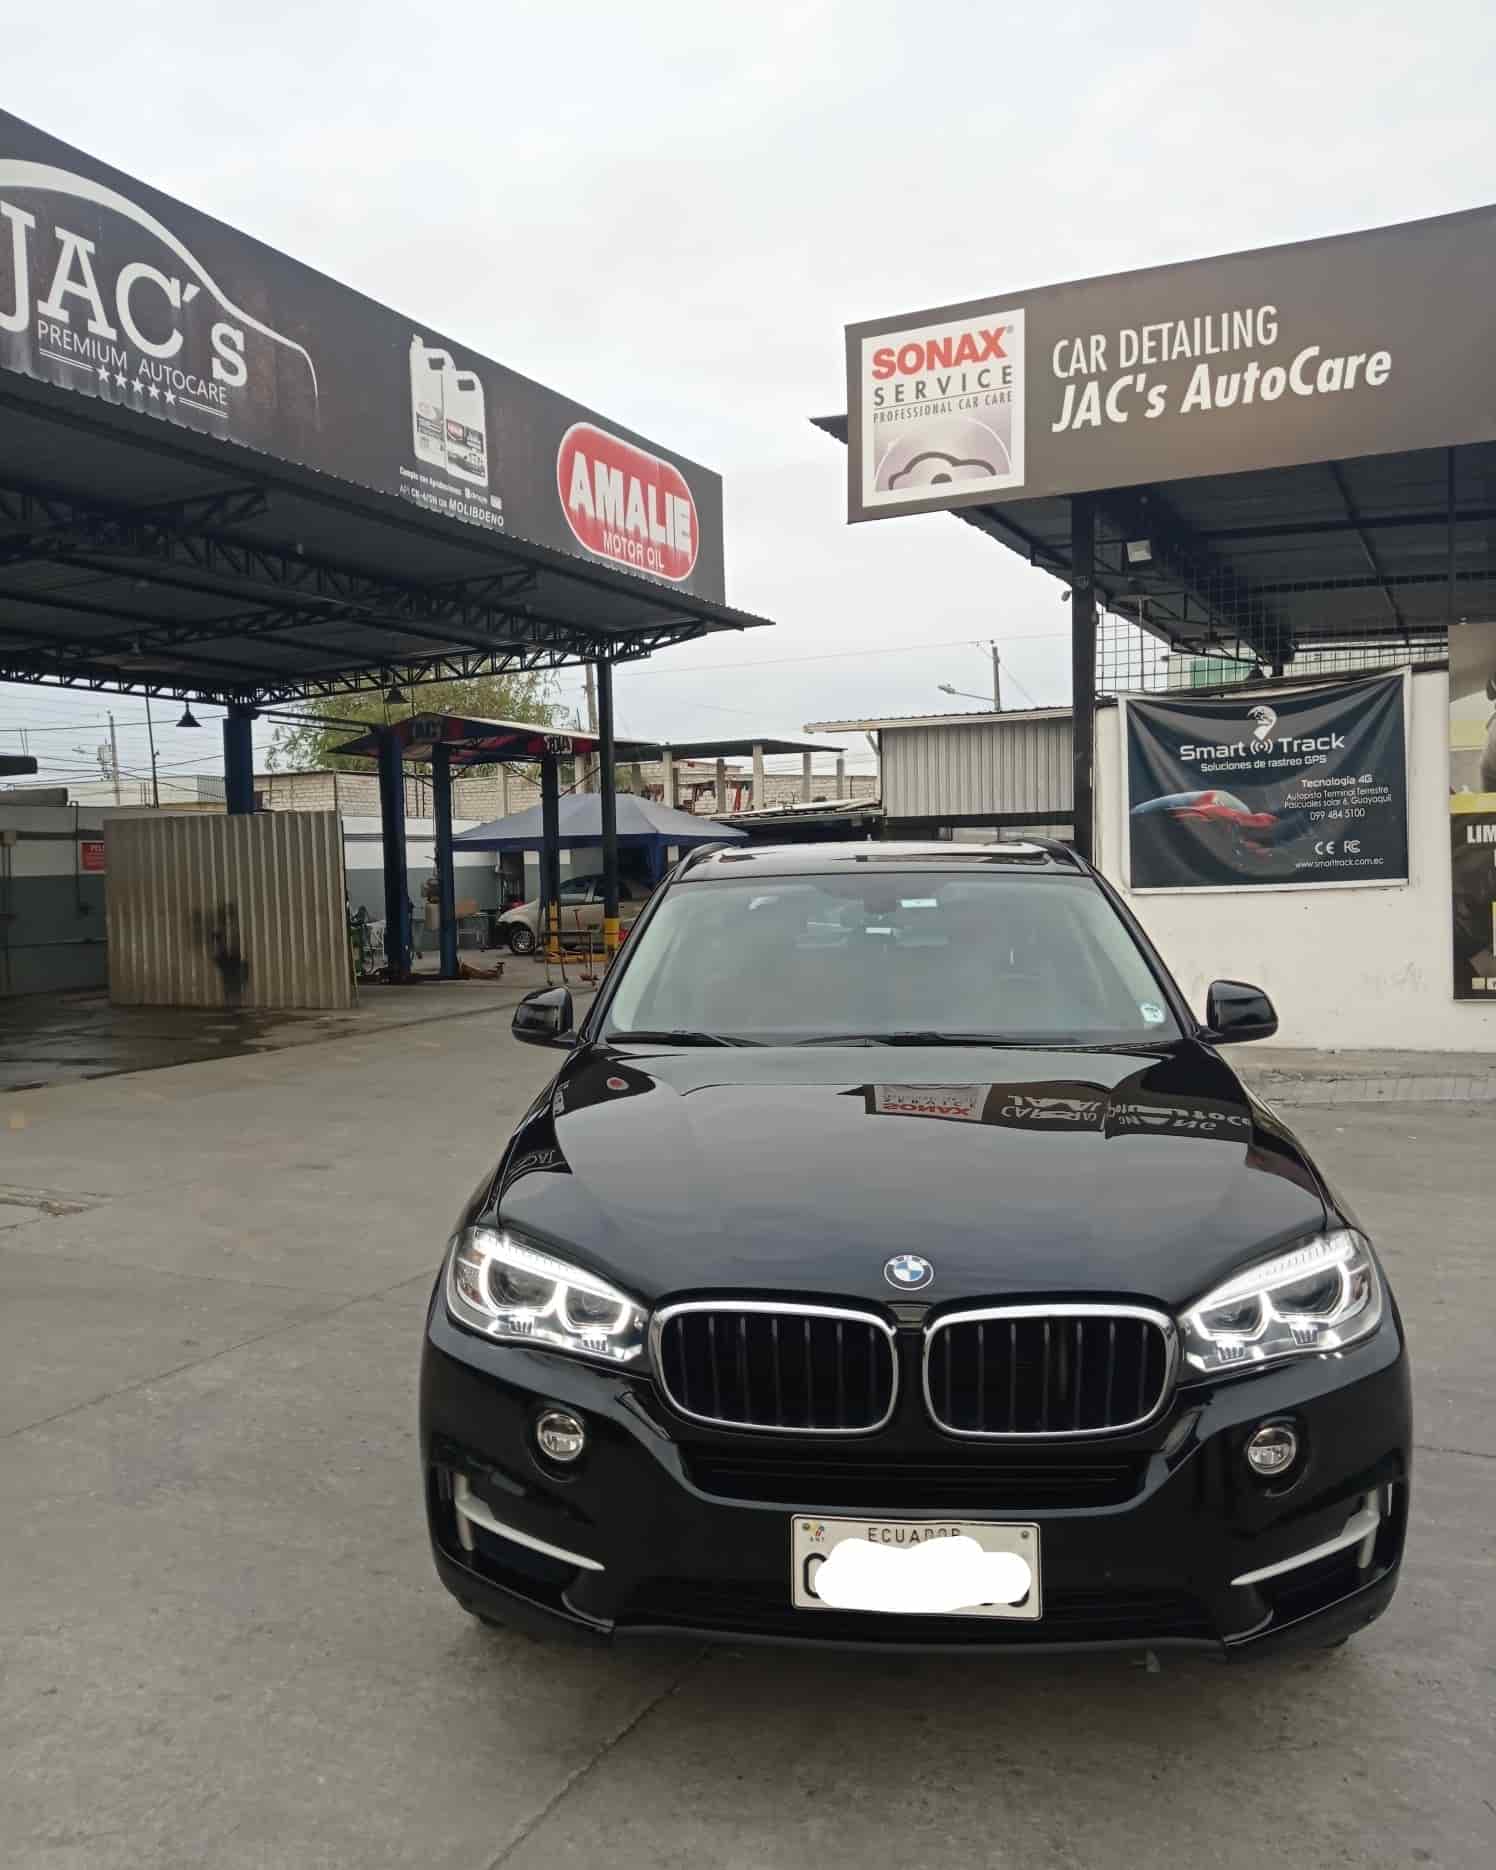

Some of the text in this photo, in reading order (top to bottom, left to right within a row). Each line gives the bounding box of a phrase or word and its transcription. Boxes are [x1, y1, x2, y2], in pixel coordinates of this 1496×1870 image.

[0, 202, 248, 387] JAC's
[872, 326, 1008, 380] SONAX
[1052, 305, 1278, 378] CAR DETAILING
[37, 319, 227, 405] PREMIUM AUTOCARE
[873, 365, 1013, 406] SERVICE
[1052, 346, 1392, 432] JAC's AutoCare
[873, 391, 1013, 424] PROFESSIONAL CAR CARE
[448, 498, 504, 527] MOLIBDENO
[569, 451, 691, 552] AMALIE
[603, 531, 665, 569] MOTOR OIL
[1180, 733, 1345, 761] Smart Track
[1200, 754, 1328, 772] Soluciones de rastreo GPS
[1358, 774, 1373, 784] 4G
[1310, 808, 1366, 821] 099 484 5100
